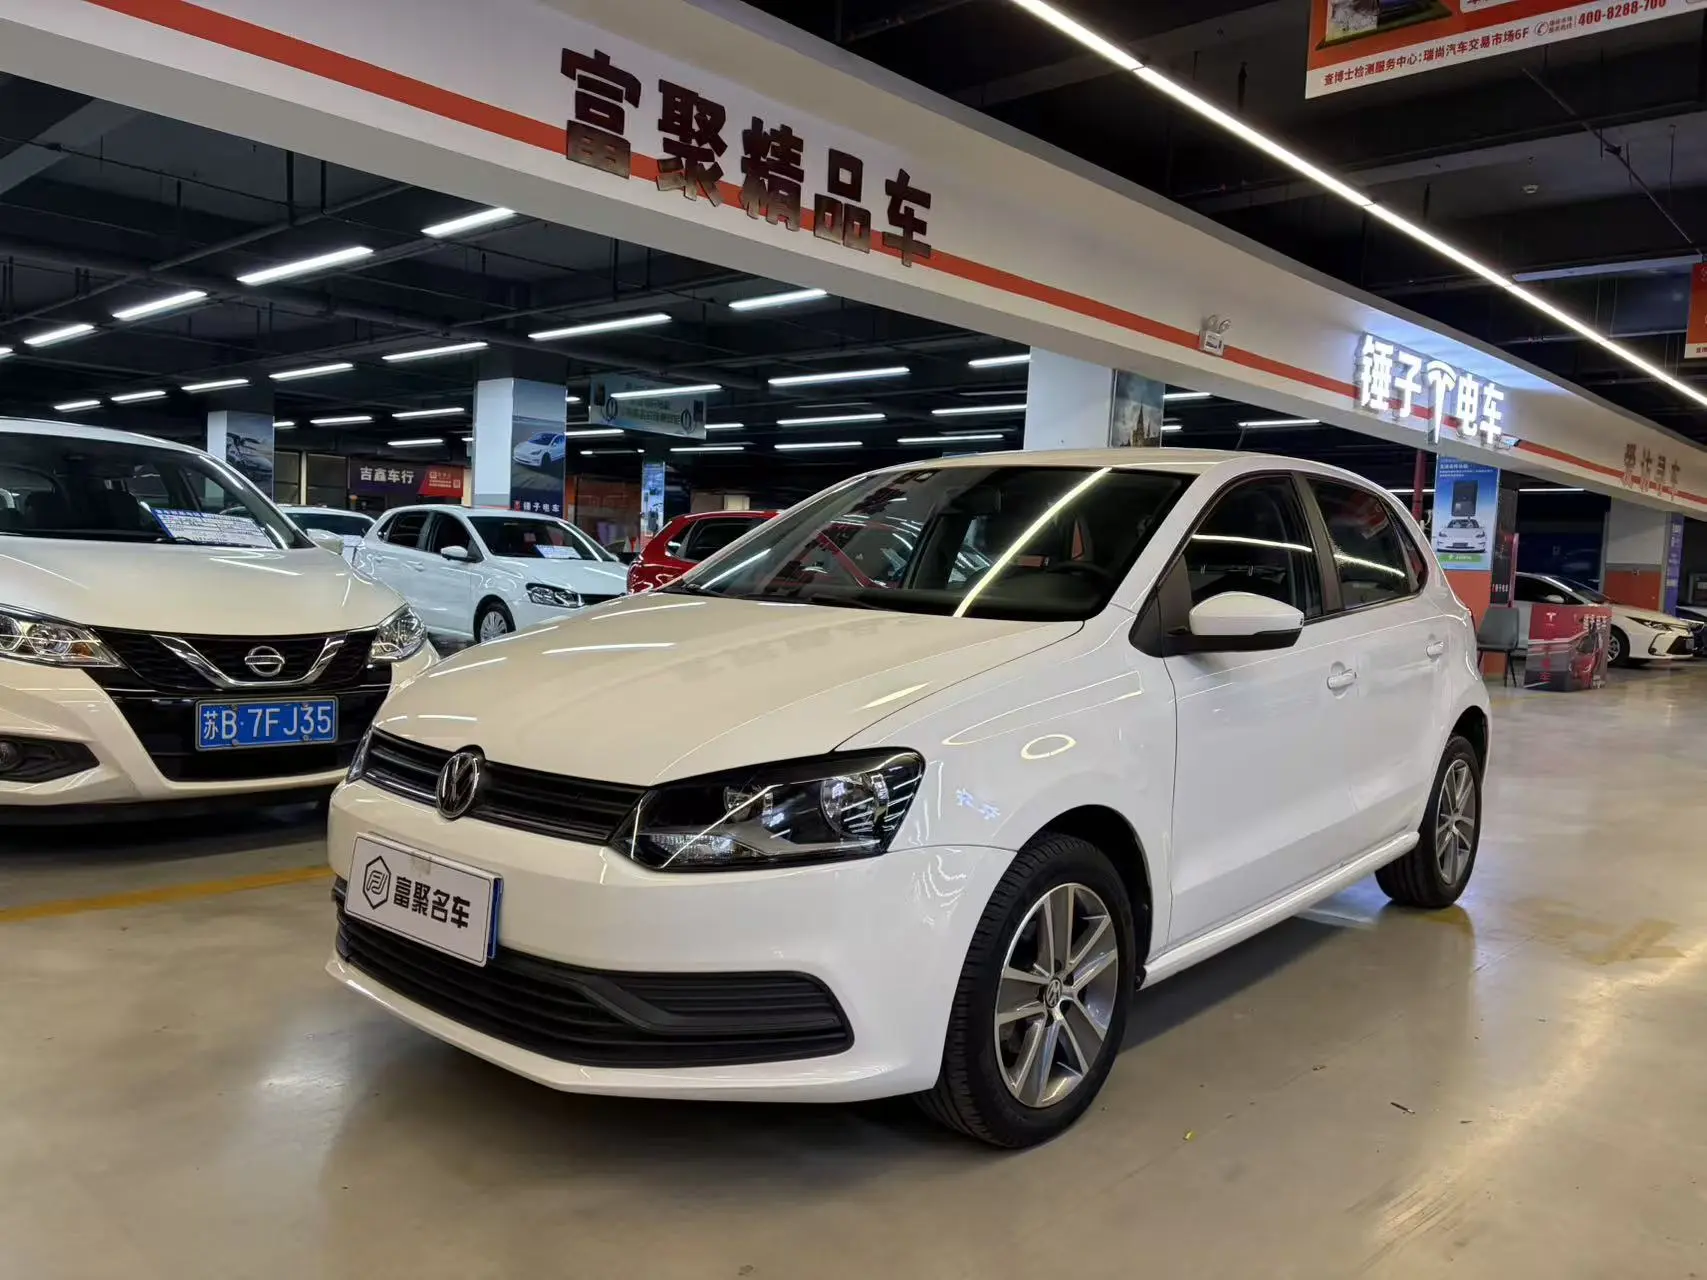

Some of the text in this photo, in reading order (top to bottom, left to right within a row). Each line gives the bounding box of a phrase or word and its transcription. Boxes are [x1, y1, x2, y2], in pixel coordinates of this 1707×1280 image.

[560, 47, 931, 267] 富聚精品车
[360, 466, 414, 484] 吉鑫车行
[393, 875, 471, 929] 富聚名车
